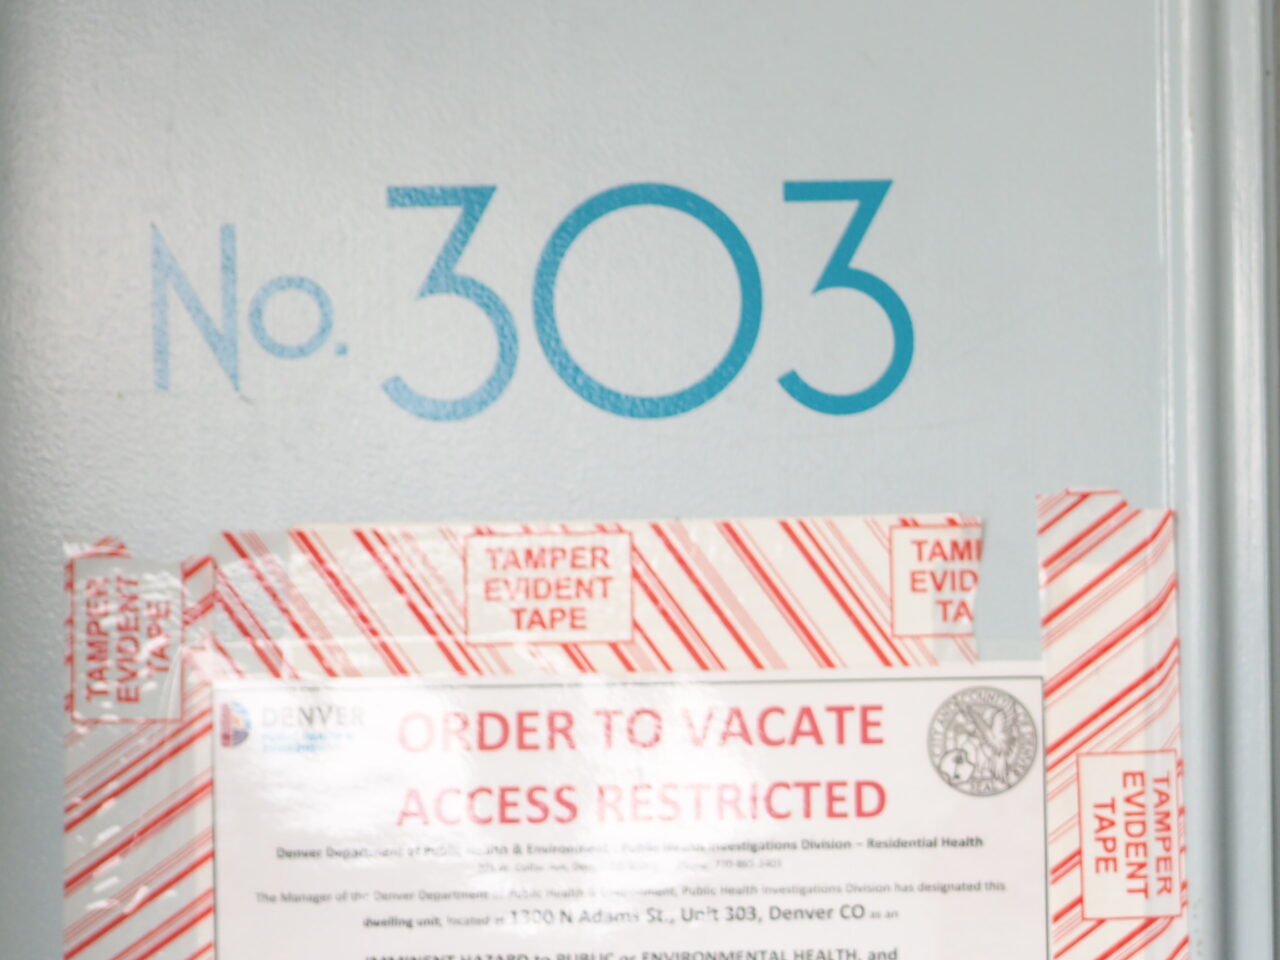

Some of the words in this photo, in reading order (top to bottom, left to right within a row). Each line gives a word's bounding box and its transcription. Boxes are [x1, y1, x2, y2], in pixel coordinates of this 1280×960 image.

[151, 220, 350, 394] No.
[381, 178, 915, 422] 303
[485, 547, 610, 570] TAMPER
[910, 539, 982, 563] TAM
[484, 576, 613, 600] EVIDENT
[86, 577, 109, 703] TAMPER
[116, 575, 139, 703] EVIDENT
[147, 600, 170, 678] TAPE
[510, 608, 587, 630] TAPE
[398, 710, 577, 754] ORDER
[593, 707, 663, 751] TO
[682, 704, 885, 748] VACATE
[396, 785, 578, 827] ACCESS
[597, 780, 887, 824] RESTRICTED
[277, 848, 321, 860] Denver
[514, 844, 521, 855] &
[801, 839, 851, 851] Division
[867, 838, 936, 850] Residential
[942, 837, 983, 848] Health
[1093, 797, 1118, 874] TAPE
[1122, 771, 1149, 899] EVIDENT
[1153, 772, 1173, 895] TAMPER
[725, 905, 761, 923] 303,
[770, 907, 833, 921] Denver
[840, 904, 864, 920] CO
